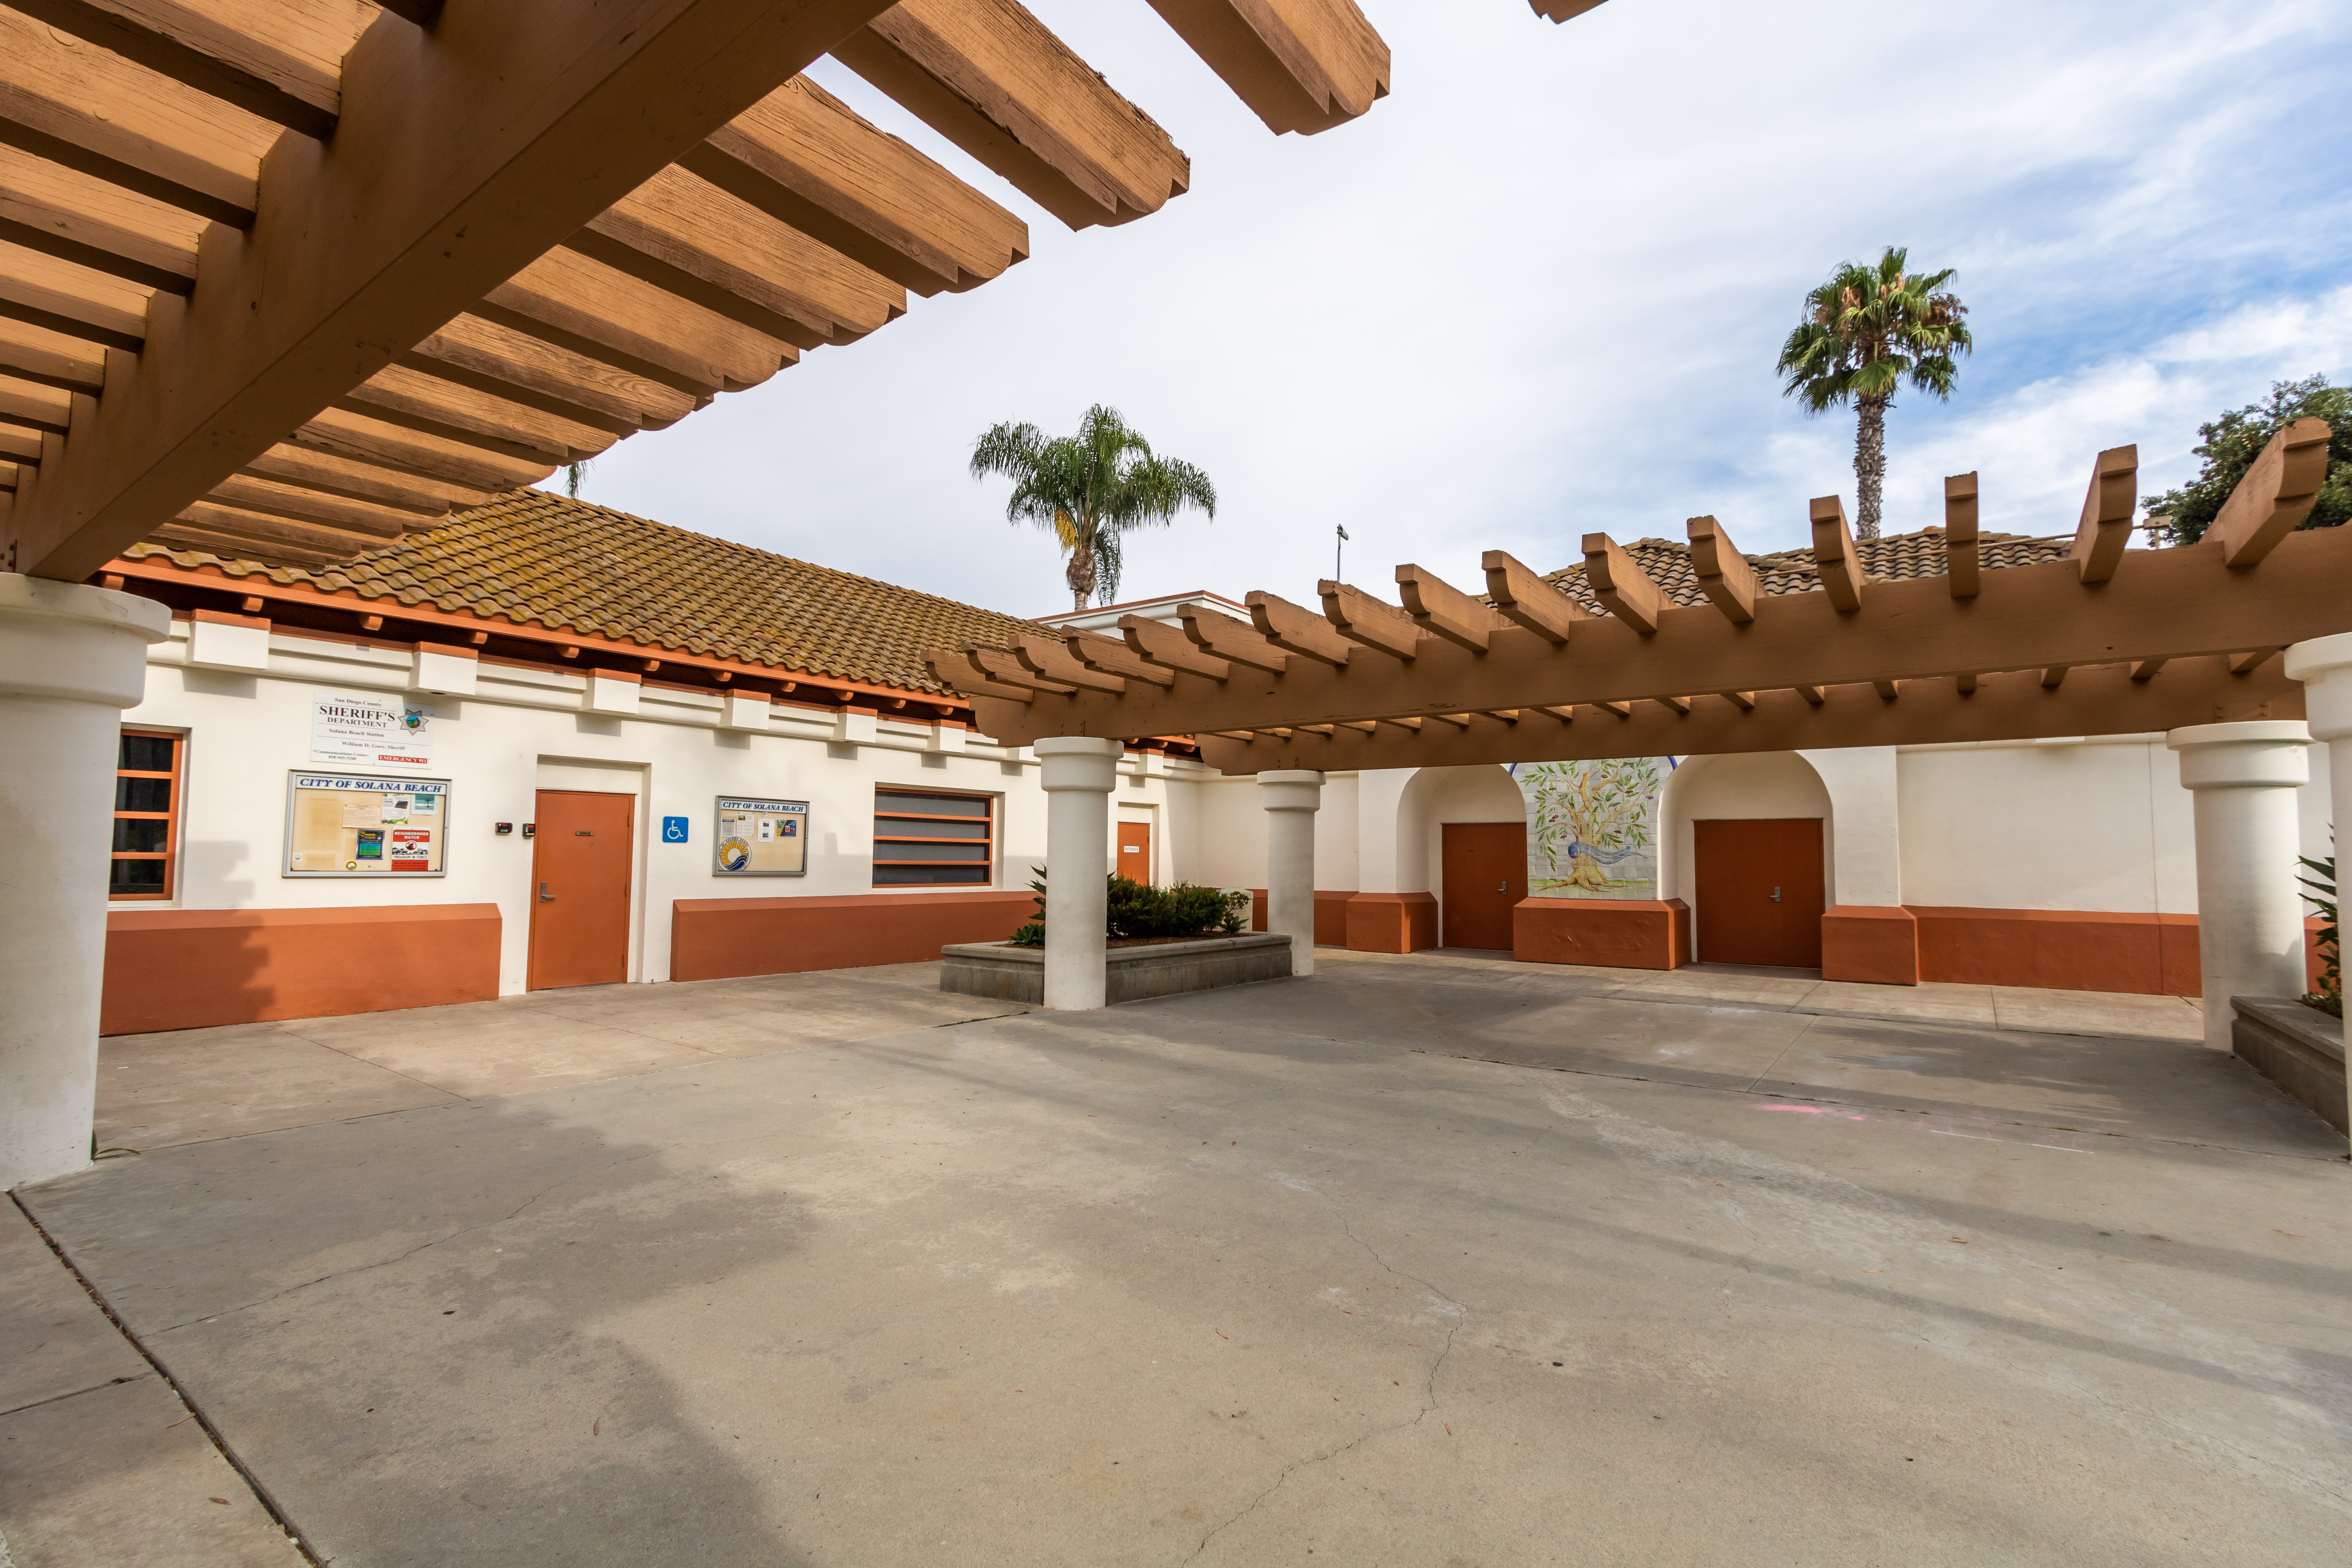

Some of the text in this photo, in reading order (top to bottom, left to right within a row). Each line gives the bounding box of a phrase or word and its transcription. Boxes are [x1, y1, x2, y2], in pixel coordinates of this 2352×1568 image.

[319, 705, 395, 722] SHERIFF'S
[327, 717, 388, 728] DEPARTMENT
[300, 778, 333, 787] CITY
[355, 781, 401, 791] SOLANA
[404, 784, 442, 793] BEACH
